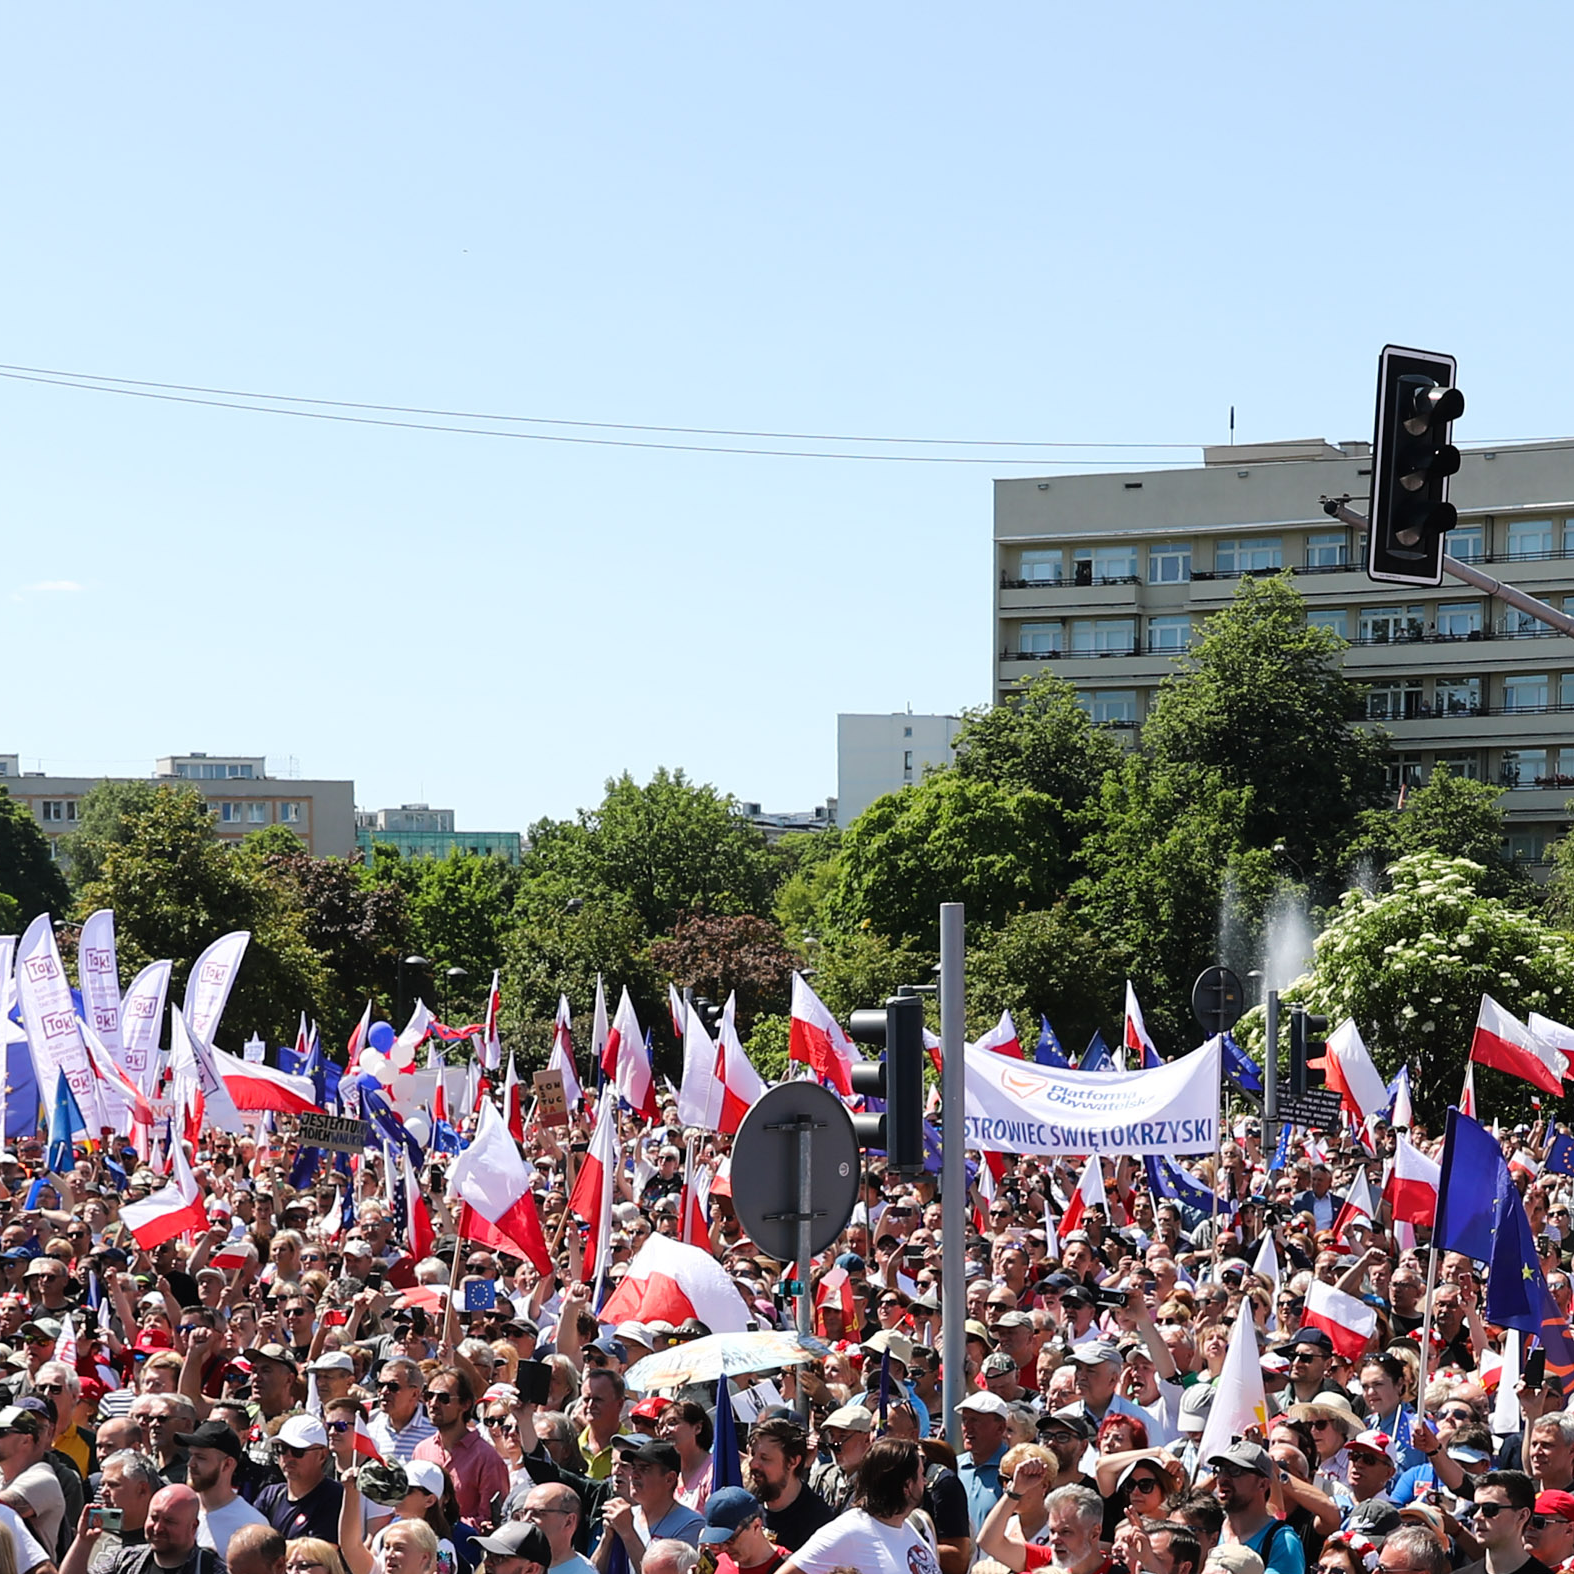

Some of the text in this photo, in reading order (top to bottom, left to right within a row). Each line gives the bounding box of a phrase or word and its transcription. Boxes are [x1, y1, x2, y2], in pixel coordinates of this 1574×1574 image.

[88, 953, 111, 968] Tak!
[204, 965, 225, 981] Tak!
[47, 1015, 75, 1032] Tak!
[96, 1012, 116, 1027] ak!
[126, 1054, 145, 1067] ak!
[1047, 1090, 1154, 1111] Obywatelsk
[301, 1112, 345, 1130] JESTEM
[963, 1115, 1212, 1152] STROWIEC ŚWIĘTOKRZYSKI
